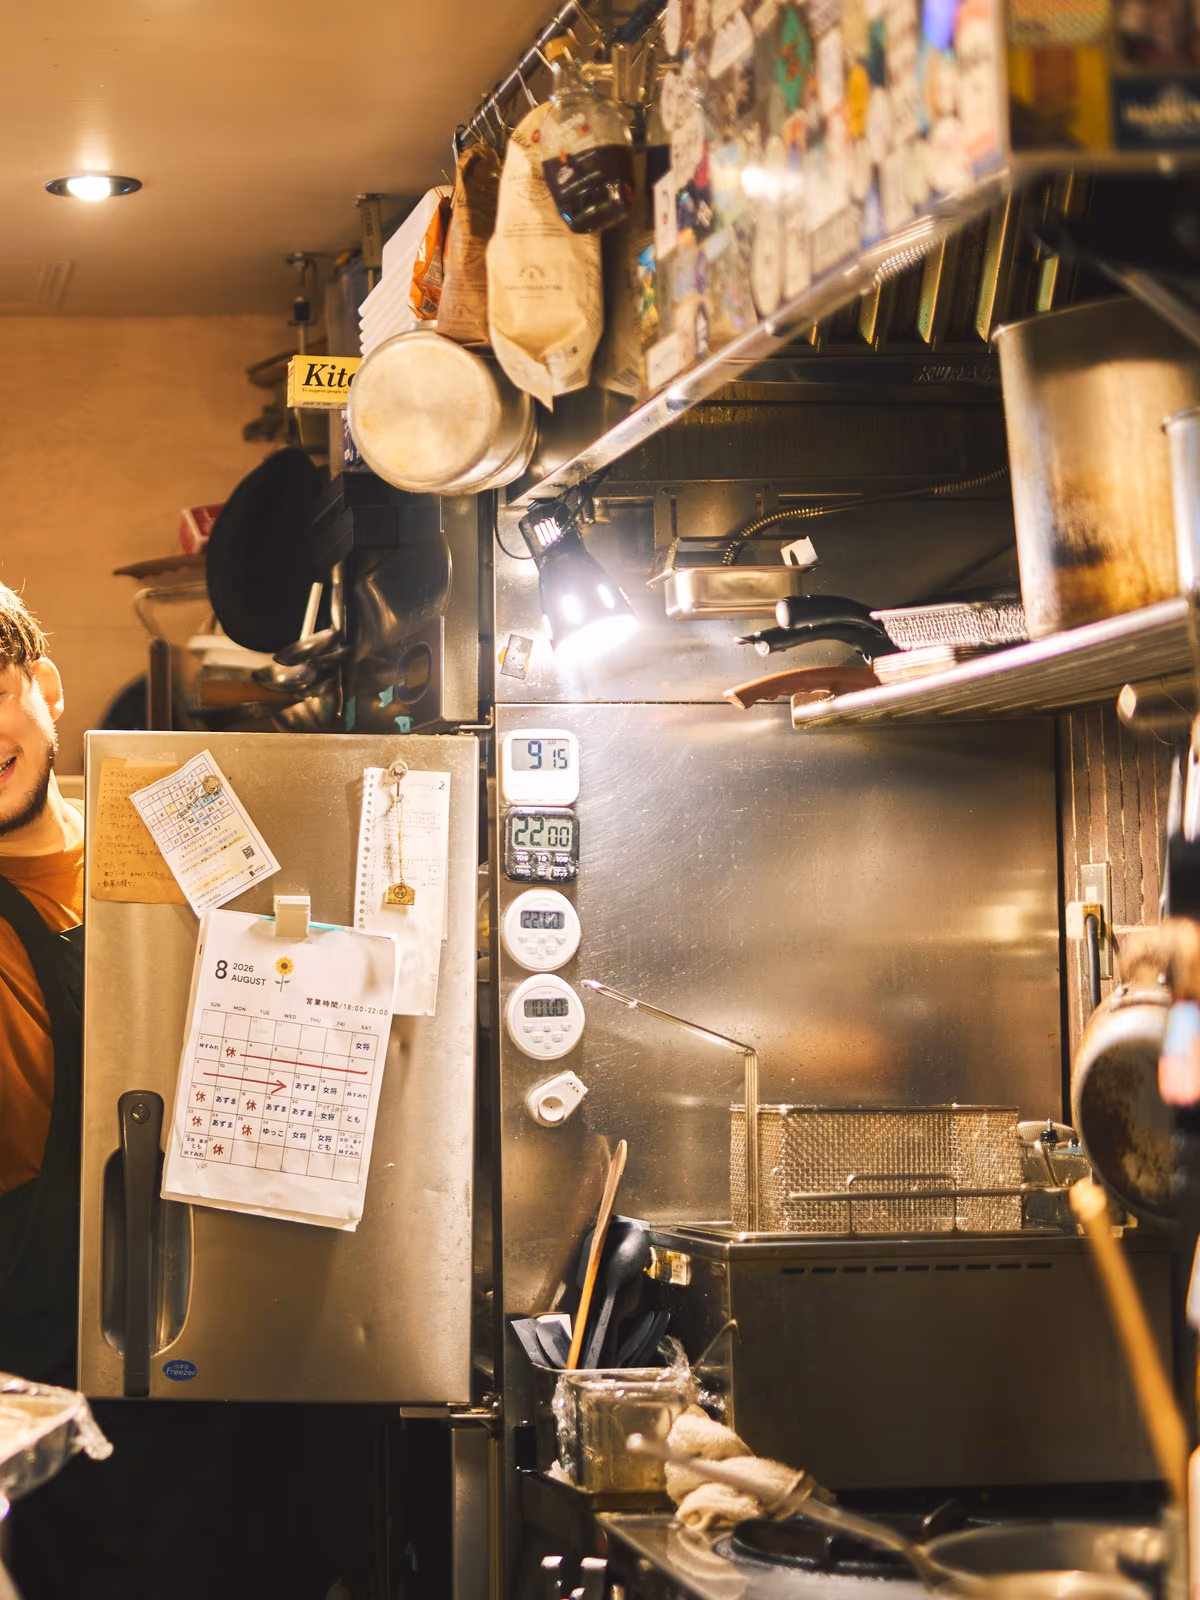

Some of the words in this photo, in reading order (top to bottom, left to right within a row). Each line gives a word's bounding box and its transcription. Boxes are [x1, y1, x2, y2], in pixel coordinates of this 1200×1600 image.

[528, 740, 542, 769] 9
[438, 782, 445, 790] 2
[514, 816, 544, 846] 22
[548, 826, 569, 847] 00
[215, 960, 228, 979] 8
[233, 963, 254, 972] 2026
[231, 974, 266, 986] AUGUST
[225, 1046, 236, 1058] 休
[195, 1091, 206, 1102] 休
[215, 1096, 236, 1105] あずま
[246, 1100, 257, 1111] 休
[266, 1104, 287, 1113] あずま
[292, 1108, 313, 1117] あずま
[192, 1116, 203, 1127] 休
[212, 1120, 233, 1128] あずま
[242, 1124, 252, 1136] 休
[262, 1128, 284, 1137] ゆっこ
[213, 1144, 224, 1155] 休
[166, 1367, 196, 1375] Freezer
